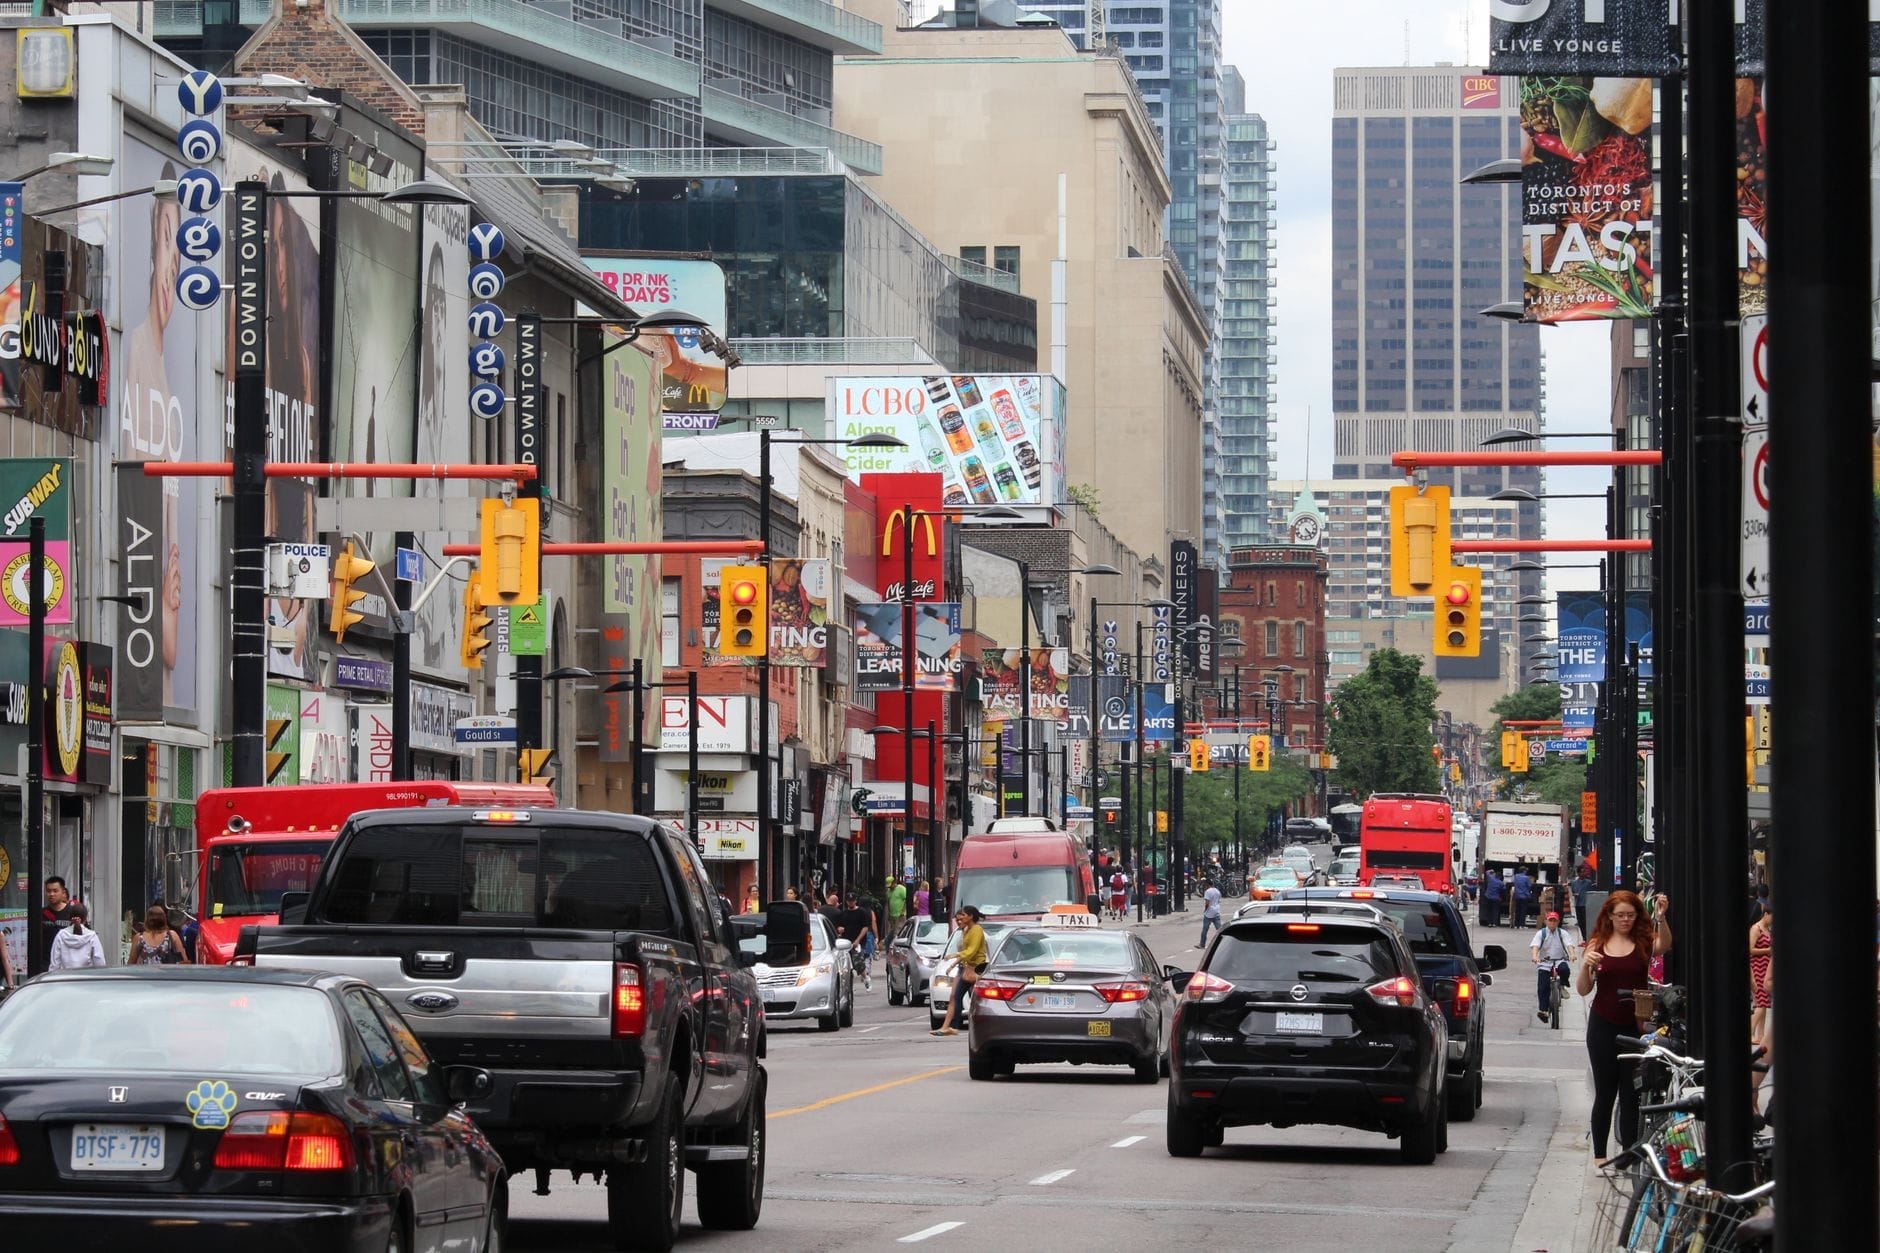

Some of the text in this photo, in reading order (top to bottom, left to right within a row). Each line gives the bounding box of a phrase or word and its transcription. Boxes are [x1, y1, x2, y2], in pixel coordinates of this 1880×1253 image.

[1499, 39, 1622, 53] LIVE YONGE
[1464, 78, 1497, 91] CIBC
[1527, 183, 1631, 199] TORONTO'S
[1529, 199, 1642, 215] DISTRICT OF
[241, 194, 257, 366] DOWNTOWN
[622, 272, 669, 286] DRINK
[622, 287, 670, 303] DAYS
[1530, 292, 1615, 305] LIVE YONGE
[521, 323, 535, 464] DOWNTOWN
[613, 359, 635, 426] Drop
[844, 387, 926, 417] LCBO
[122, 379, 183, 463] ALDO
[845, 455, 892, 471] Cider
[3, 463, 62, 536] SUBWAY
[612, 486, 628, 538] For
[284, 545, 327, 557] POLICE
[4, 555, 32, 581] MARB
[126, 516, 155, 668] ALDO
[1558, 649, 1596, 665] THE
[465, 730, 492, 740] Gould
[720, 839, 742, 849] Nikon
[1057, 914, 1090, 926] TAXI
[76, 1135, 161, 1159] BTSF 779
